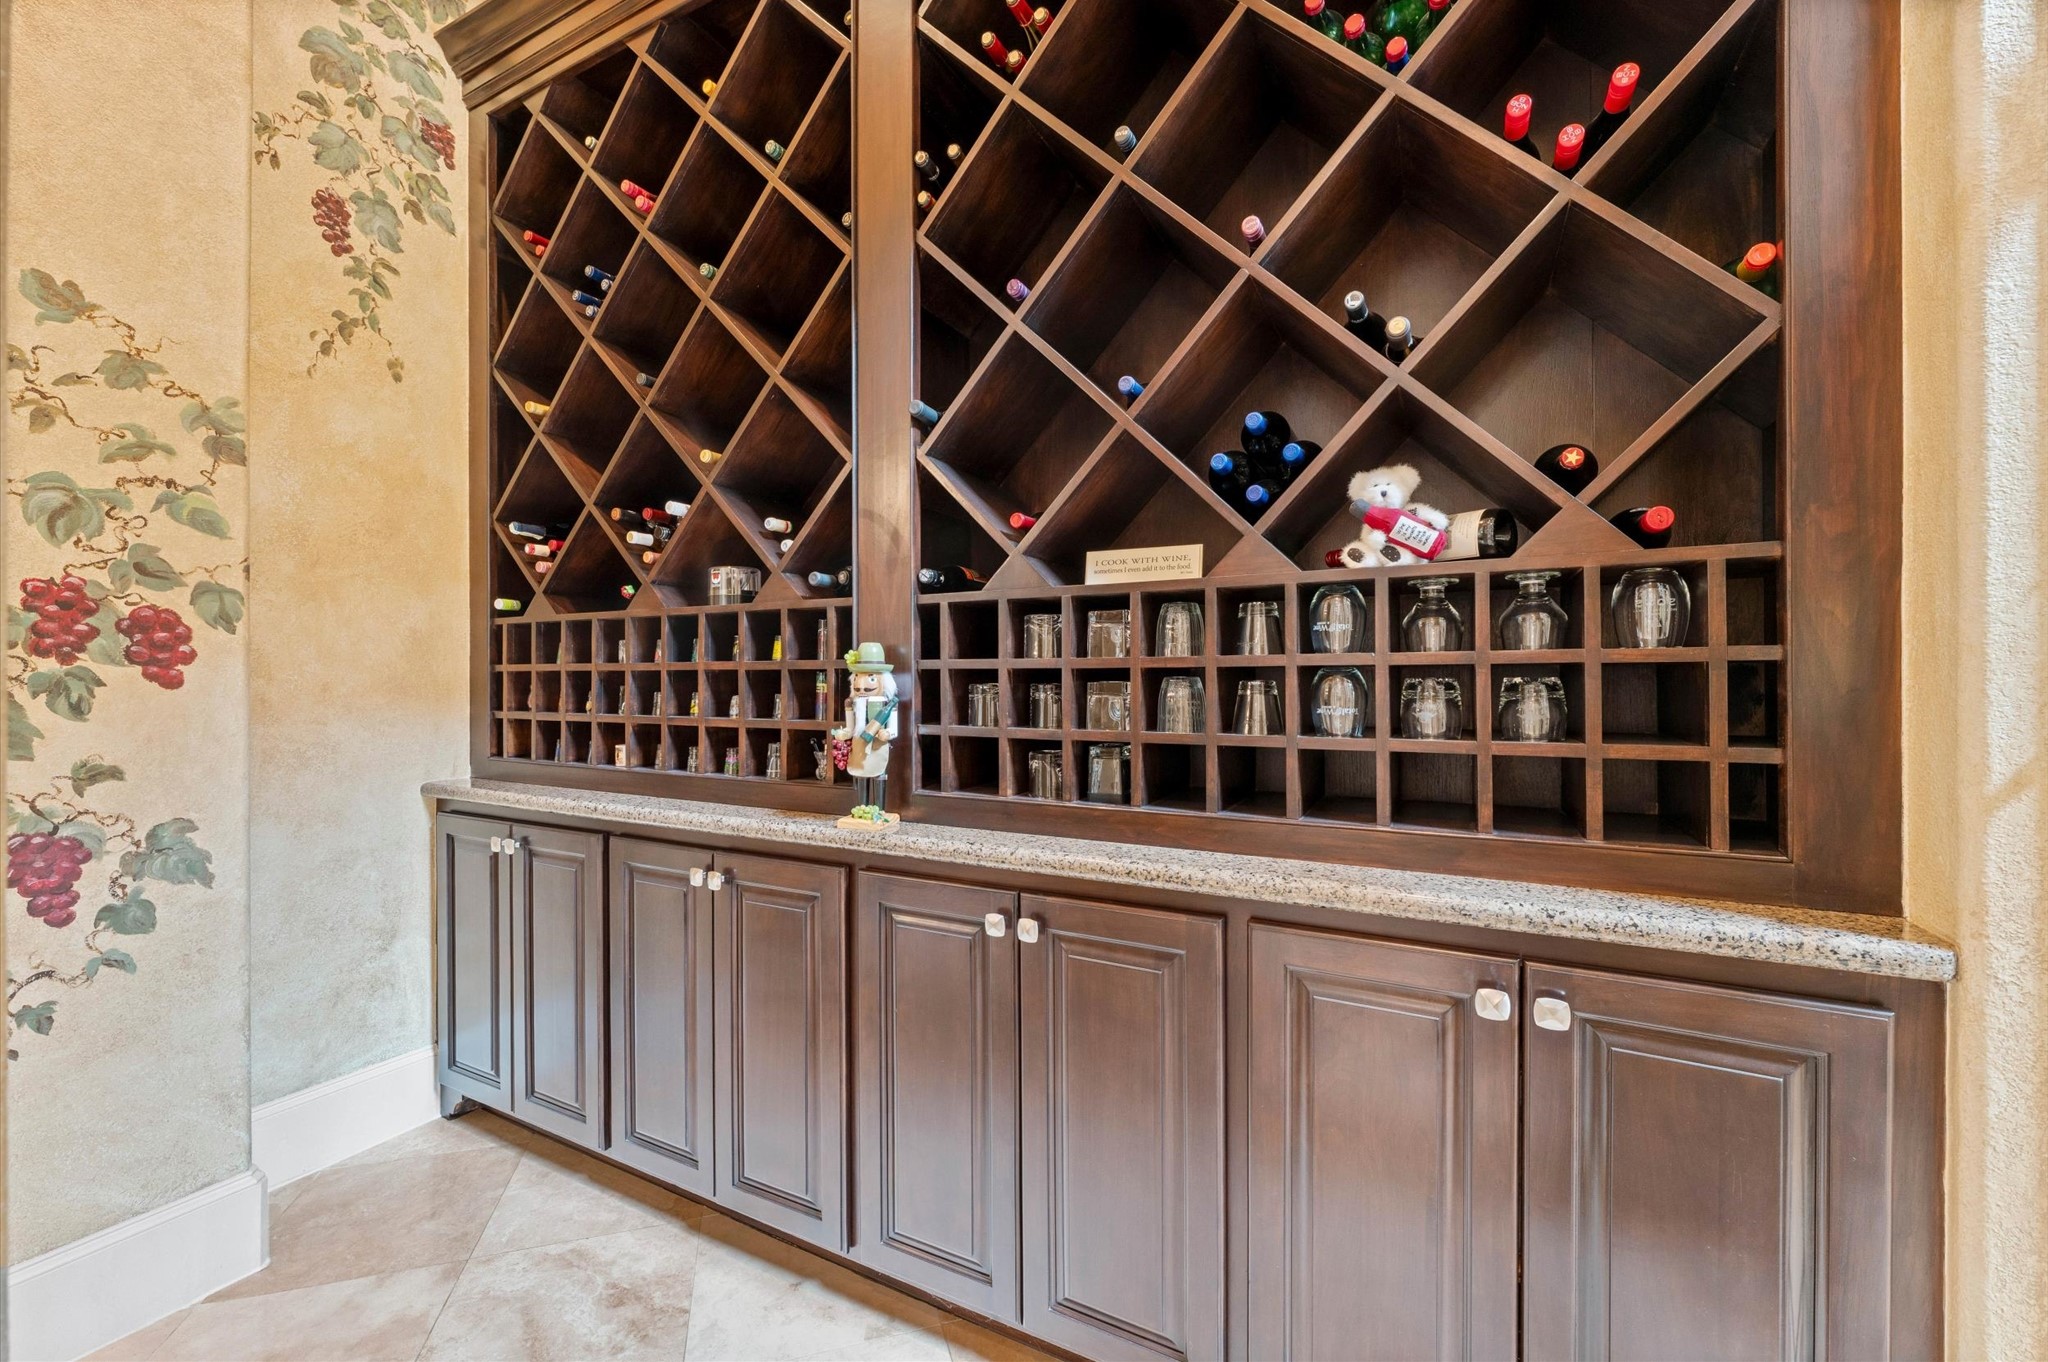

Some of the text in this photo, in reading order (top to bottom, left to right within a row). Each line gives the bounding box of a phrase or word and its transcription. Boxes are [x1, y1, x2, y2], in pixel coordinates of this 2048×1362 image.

[1101, 558, 1128, 566] COOK
[1131, 556, 1158, 564] WITH
[1166, 563, 1176, 571] the
